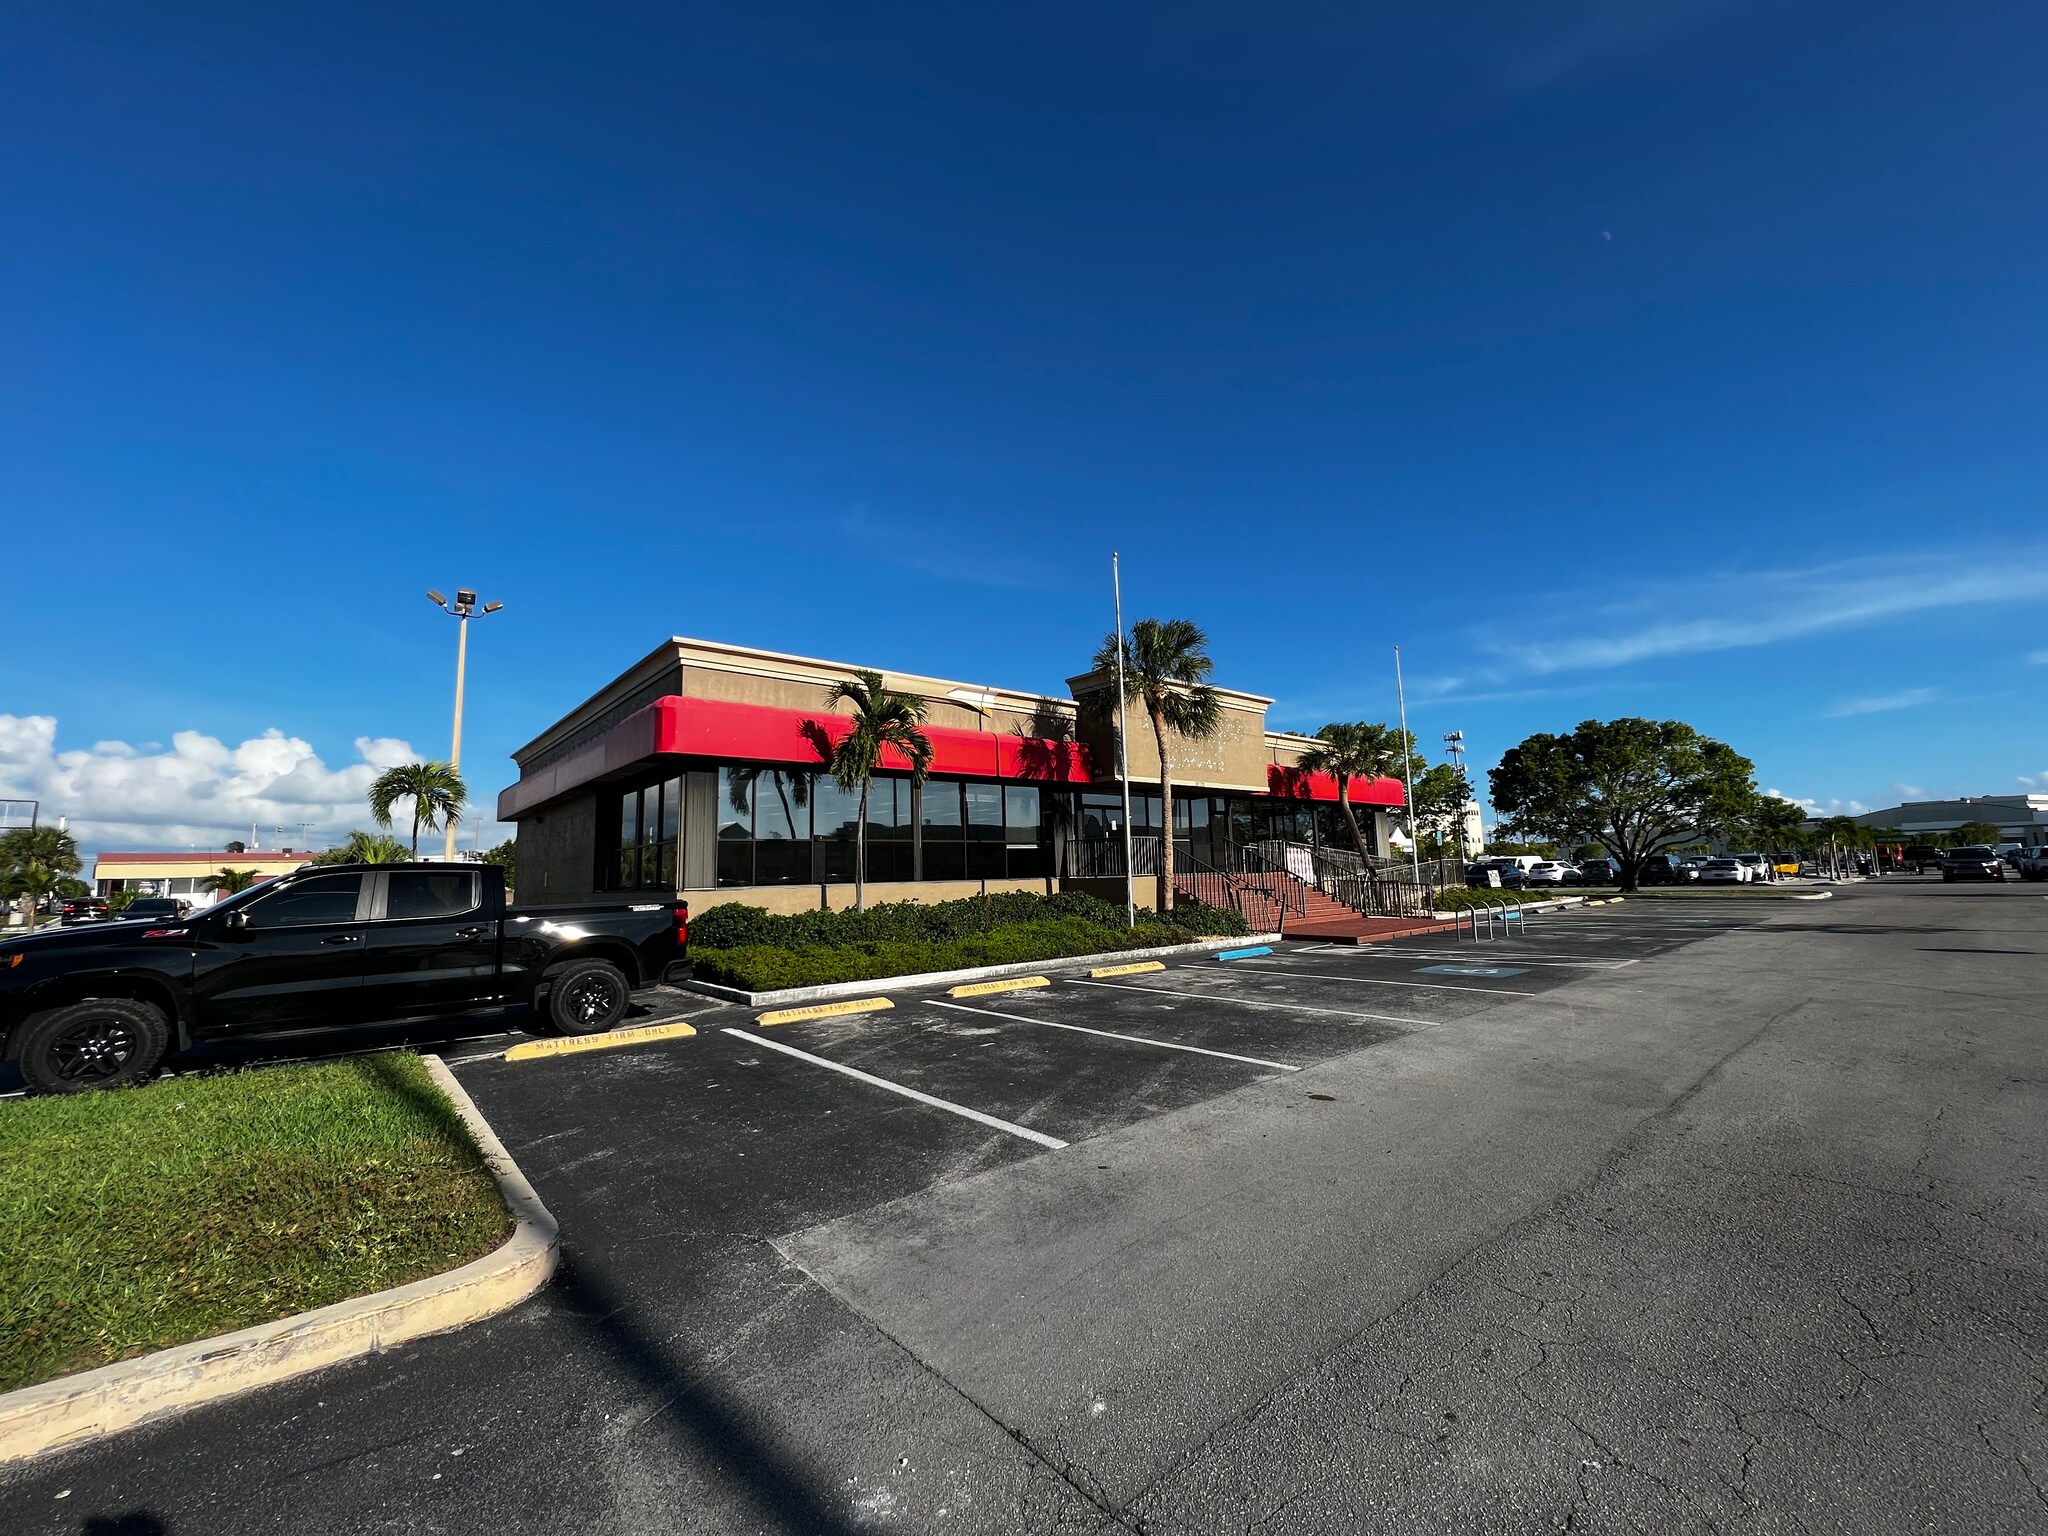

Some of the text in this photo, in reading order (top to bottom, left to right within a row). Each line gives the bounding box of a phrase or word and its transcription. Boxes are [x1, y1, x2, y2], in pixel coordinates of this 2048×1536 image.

[535, 1026, 672, 1051] MATTRESS FIRM ONLY
